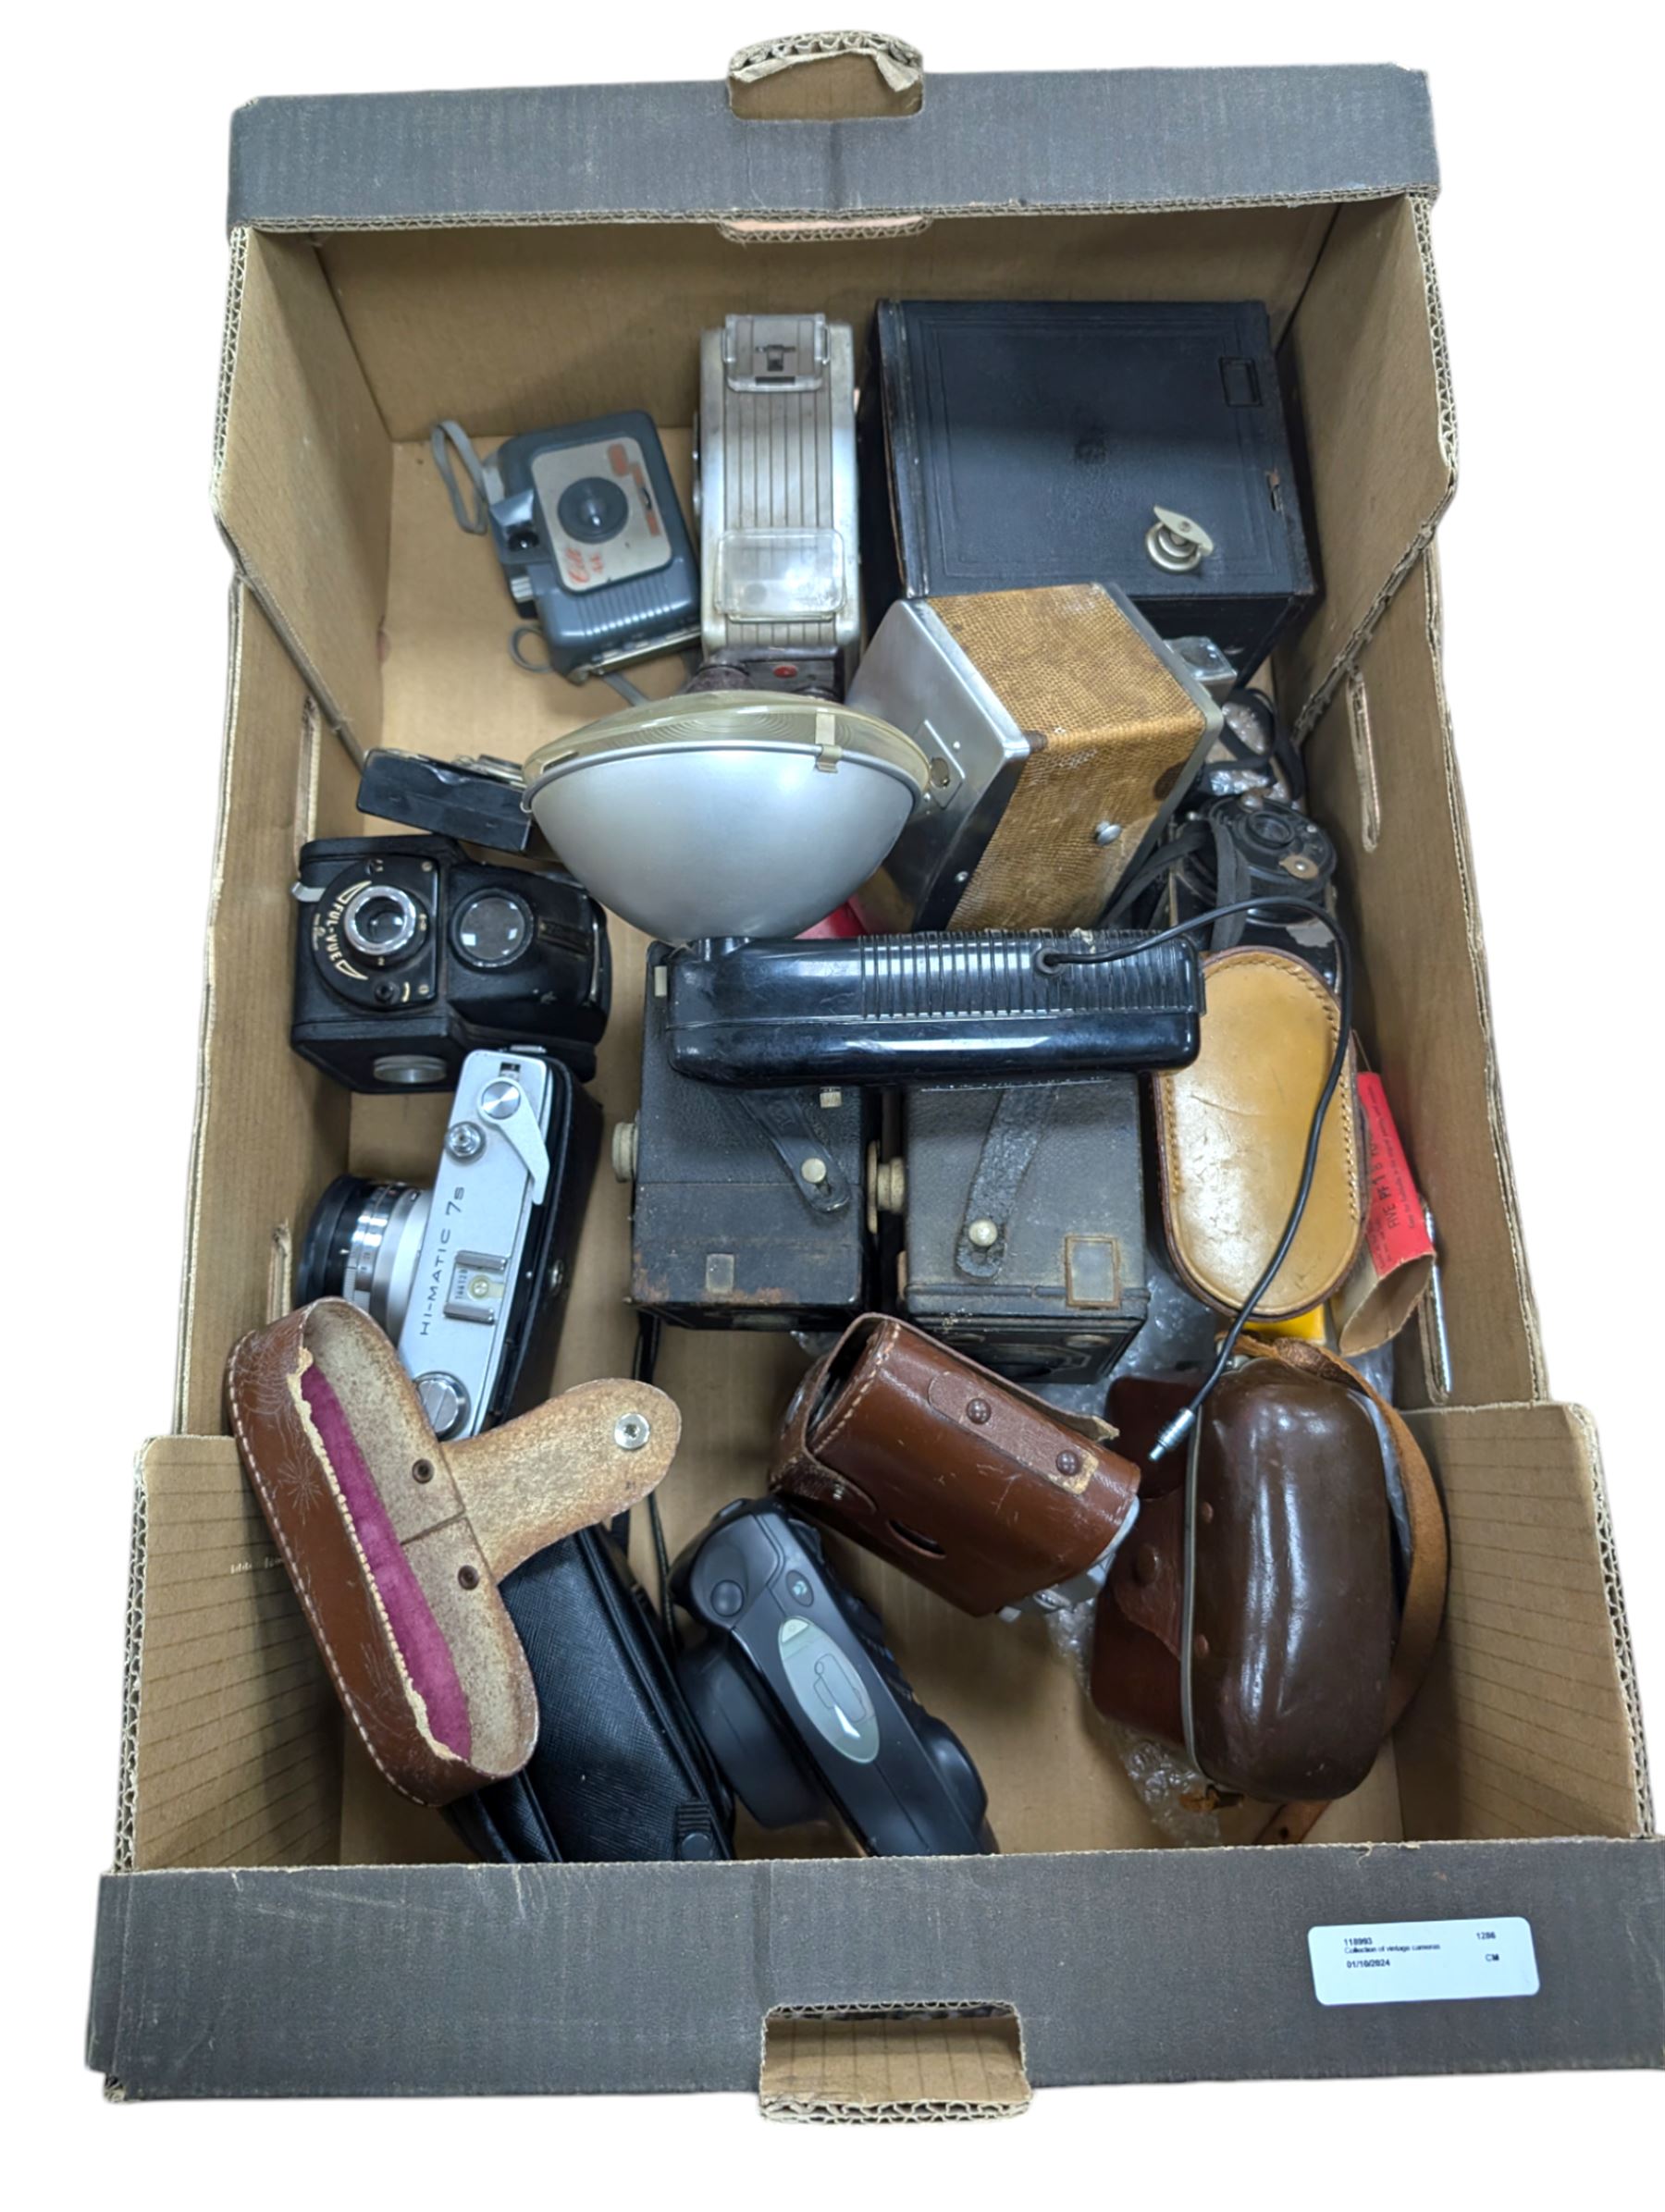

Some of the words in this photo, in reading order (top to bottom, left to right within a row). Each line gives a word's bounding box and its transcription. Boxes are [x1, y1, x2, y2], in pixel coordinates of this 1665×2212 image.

[326, 902, 344, 962] FUL-VUE
[1383, 1203, 1400, 1229] FIVE
[420, 1228, 450, 1335] HI-MATIC
[1344, 1946, 1377, 1954] Collection
[1387, 1944, 1411, 1953] vintage
[1412, 1943, 1441, 1951] cameras
[1347, 1959, 1390, 1969] 01/10/2024
